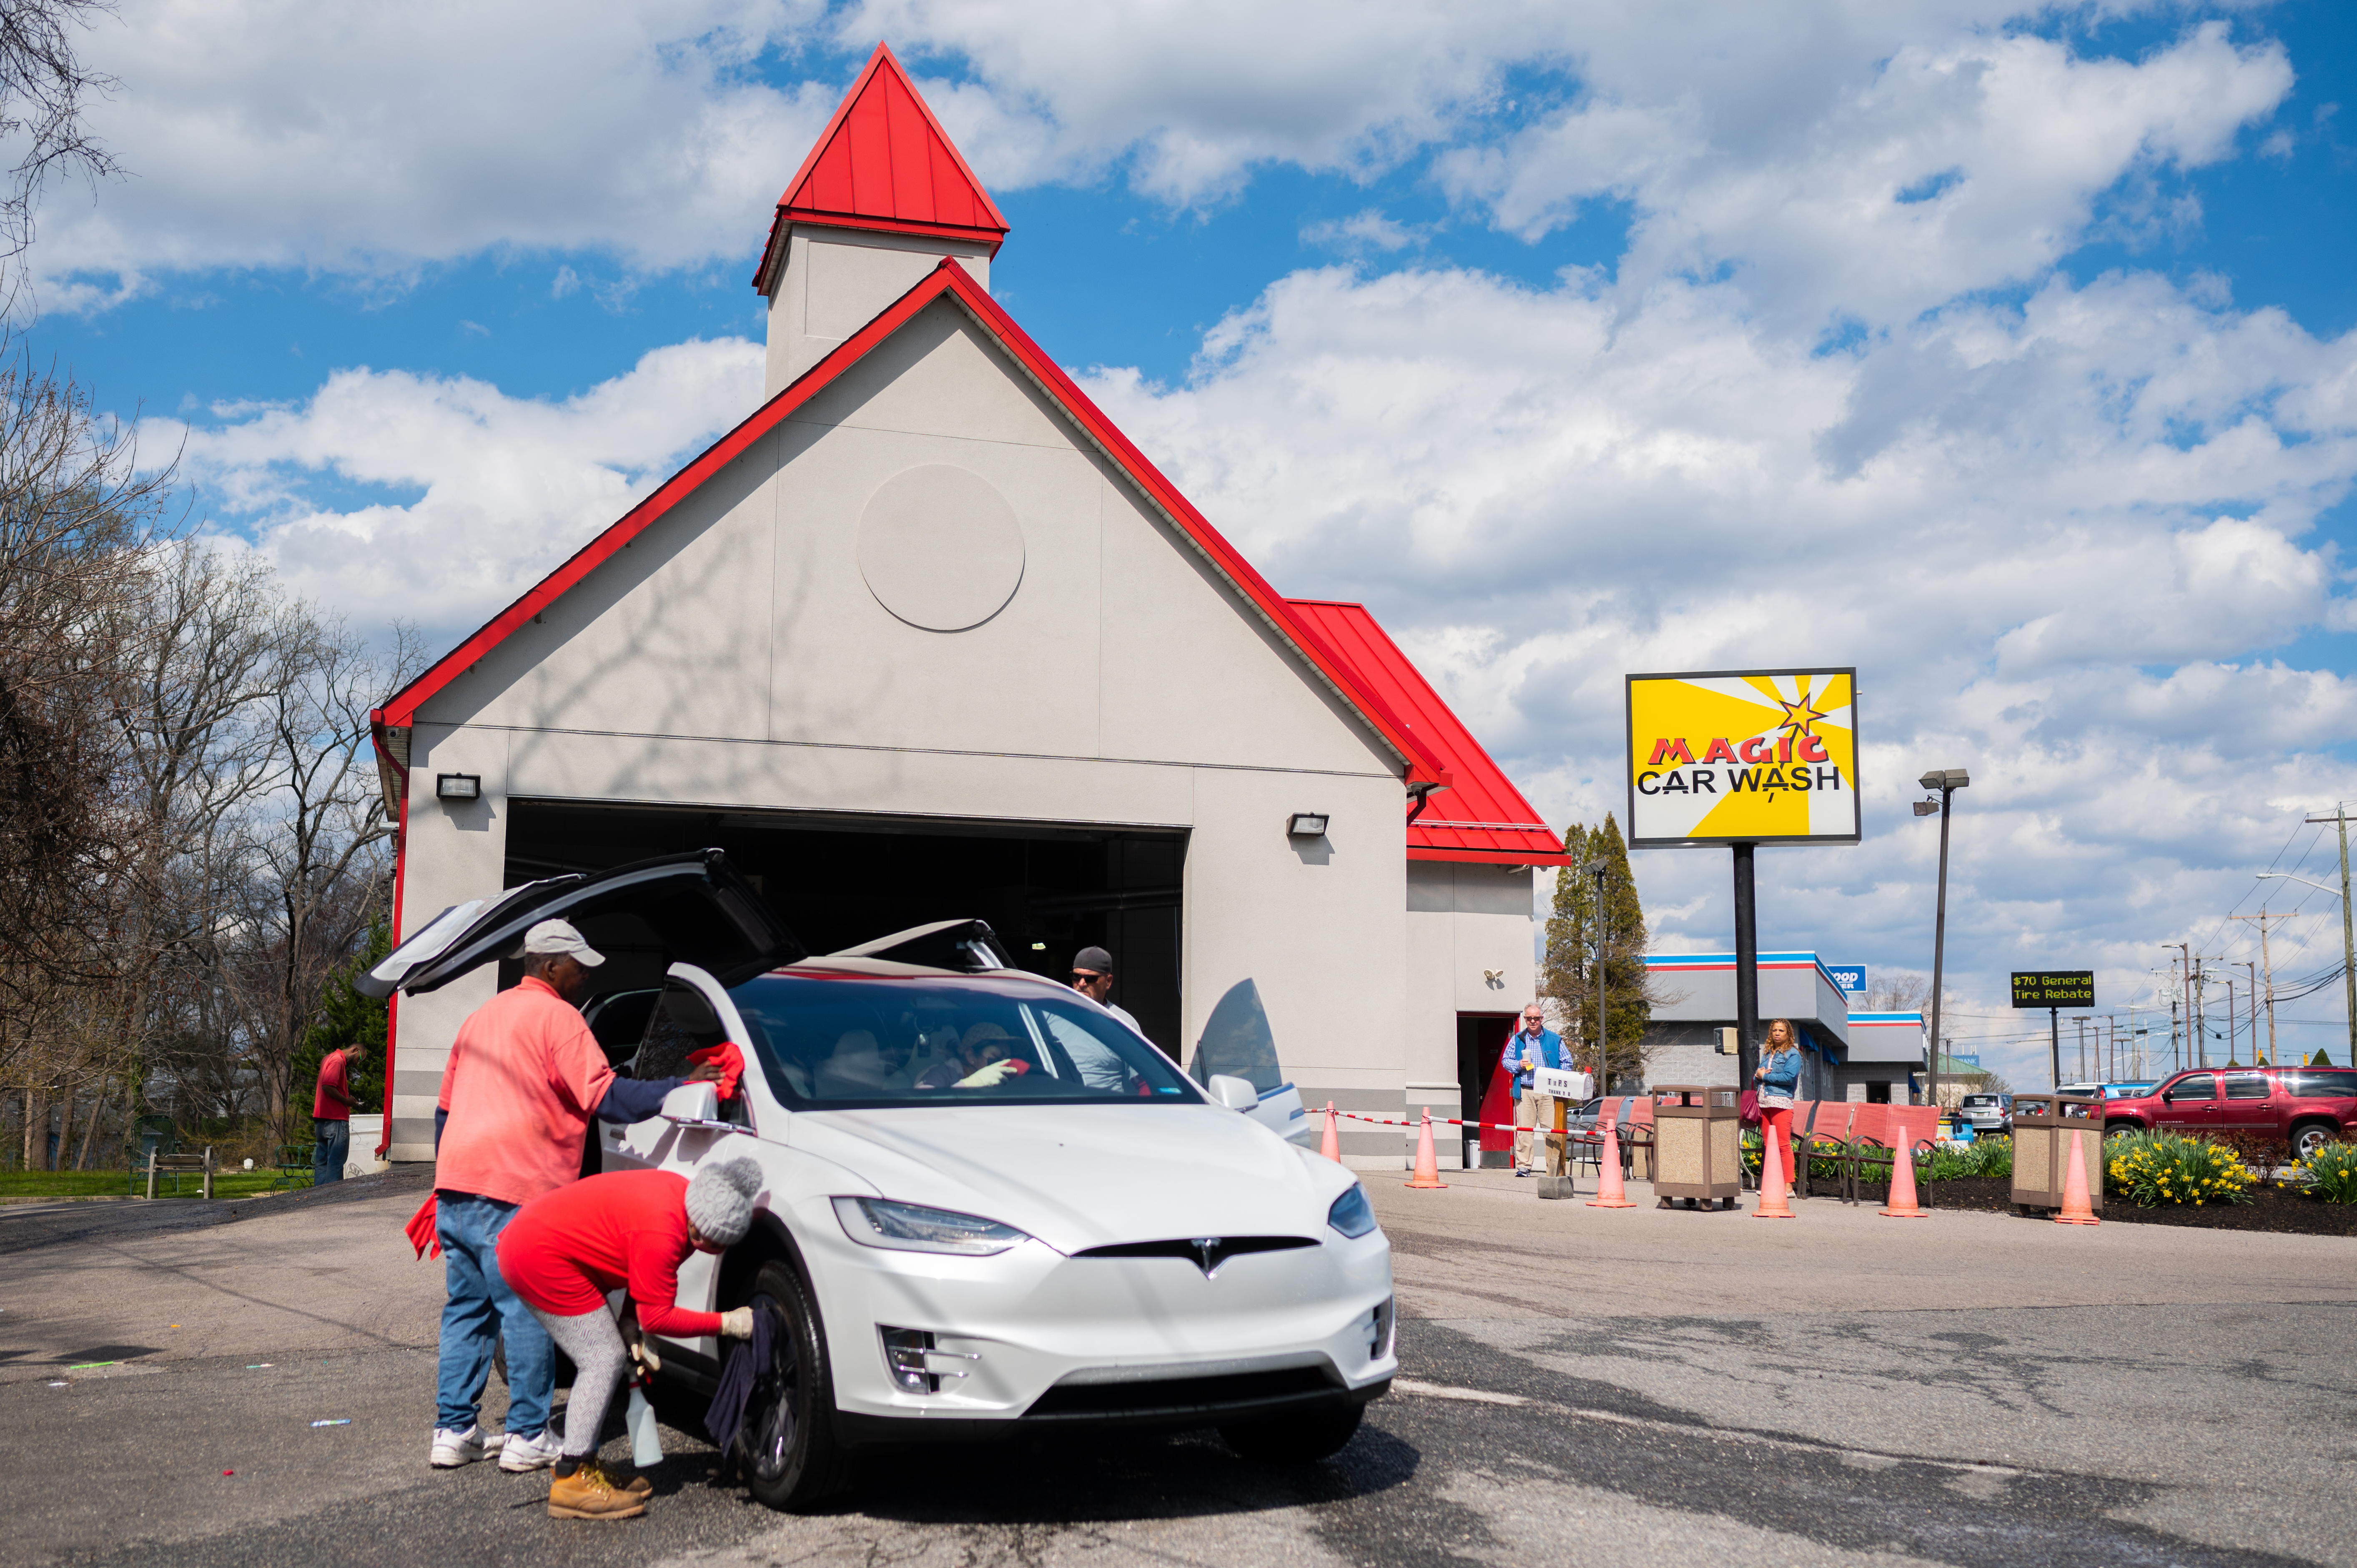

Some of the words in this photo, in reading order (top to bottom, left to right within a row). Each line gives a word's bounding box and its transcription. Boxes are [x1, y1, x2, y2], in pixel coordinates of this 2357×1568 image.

[1647, 735, 1829, 765] MAGIC
[1637, 770, 1717, 795] CAR
[1727, 766, 1840, 793] WASH
[1832, 972, 1858, 981] OOD
[2013, 976, 2036, 986] $70
[2042, 975, 2091, 985] General
[2014, 989, 2040, 999] Tire
[2045, 989, 2091, 999] Rebate
